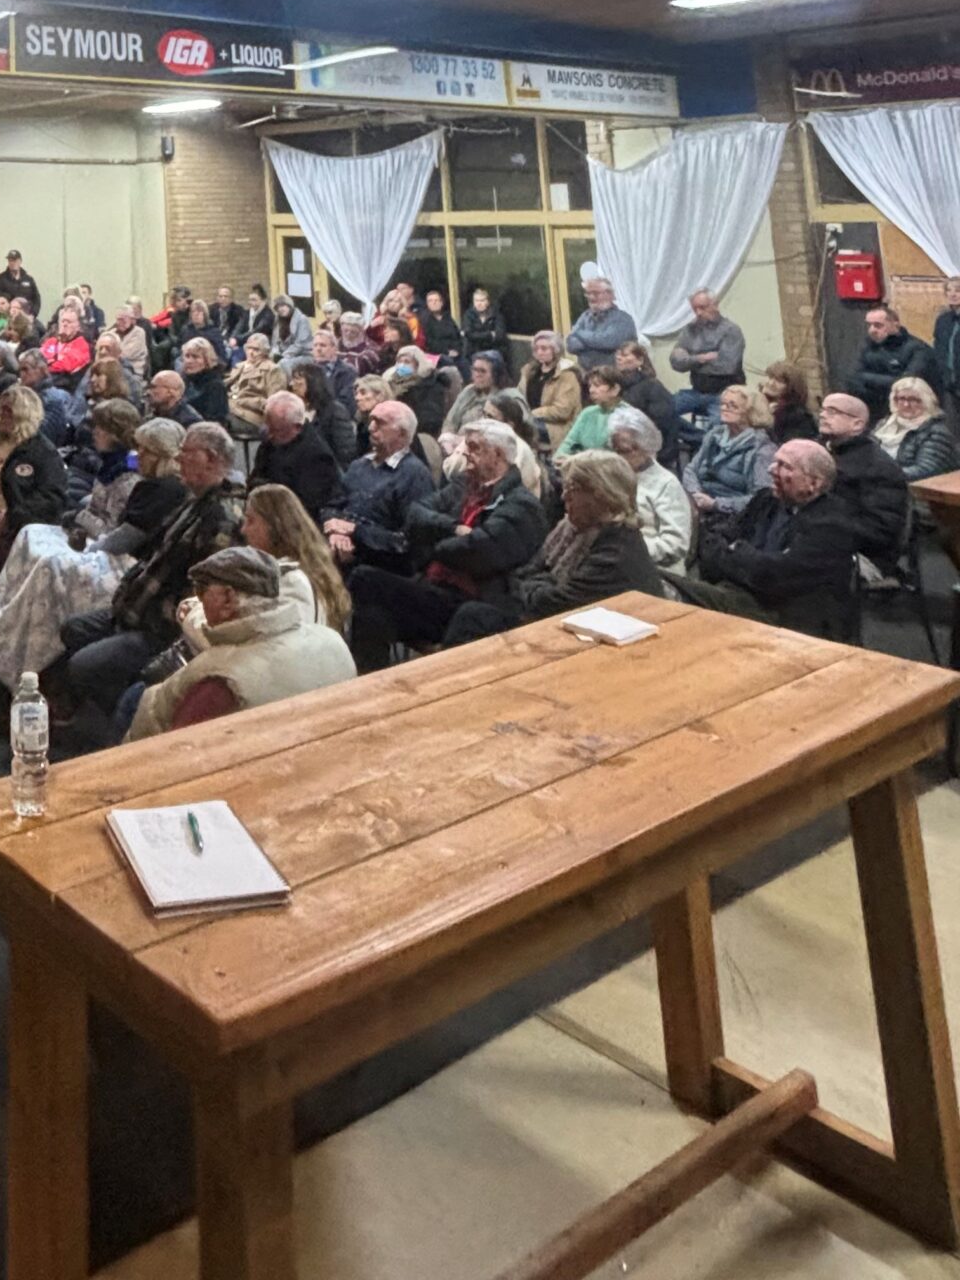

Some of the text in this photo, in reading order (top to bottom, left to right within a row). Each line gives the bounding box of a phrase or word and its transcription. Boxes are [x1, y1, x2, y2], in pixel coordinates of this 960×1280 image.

[25, 24, 144, 62] SEYMOUR
[163, 36, 208, 66] IGA
[230, 43, 284, 67] LIQUOR
[410, 54, 439, 74] 1300
[443, 57, 458, 77] 77
[462, 59, 478, 79] 33
[481, 61, 497, 81] 52
[546, 69, 668, 93] MAWSONS CONCRETE
